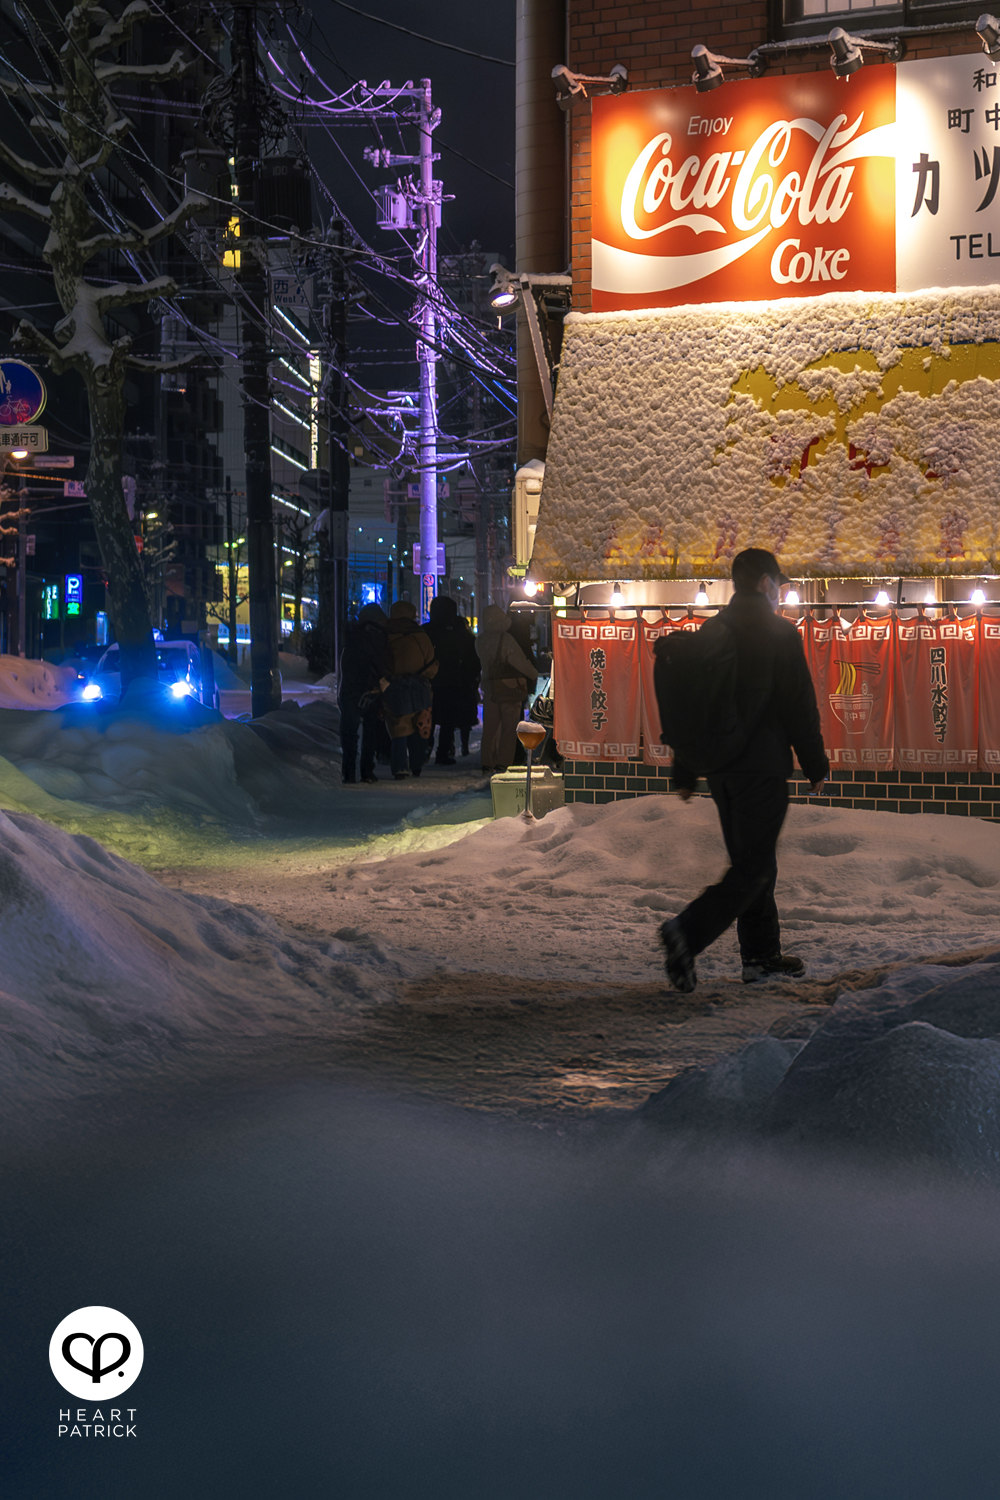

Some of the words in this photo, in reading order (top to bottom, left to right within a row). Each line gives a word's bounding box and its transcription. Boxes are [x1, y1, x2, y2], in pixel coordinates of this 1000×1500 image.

[686, 113, 733, 138] Enjoy
[619, 111, 864, 240] Coca-Cola
[770, 238, 851, 285] Coke
[275, 295, 296, 303] West
[0, 433, 39, 446] 車通行可
[68, 577, 80, 595] P
[590, 648, 608, 731] 焼き餃子
[930, 647, 949, 744] 四川水餃子
